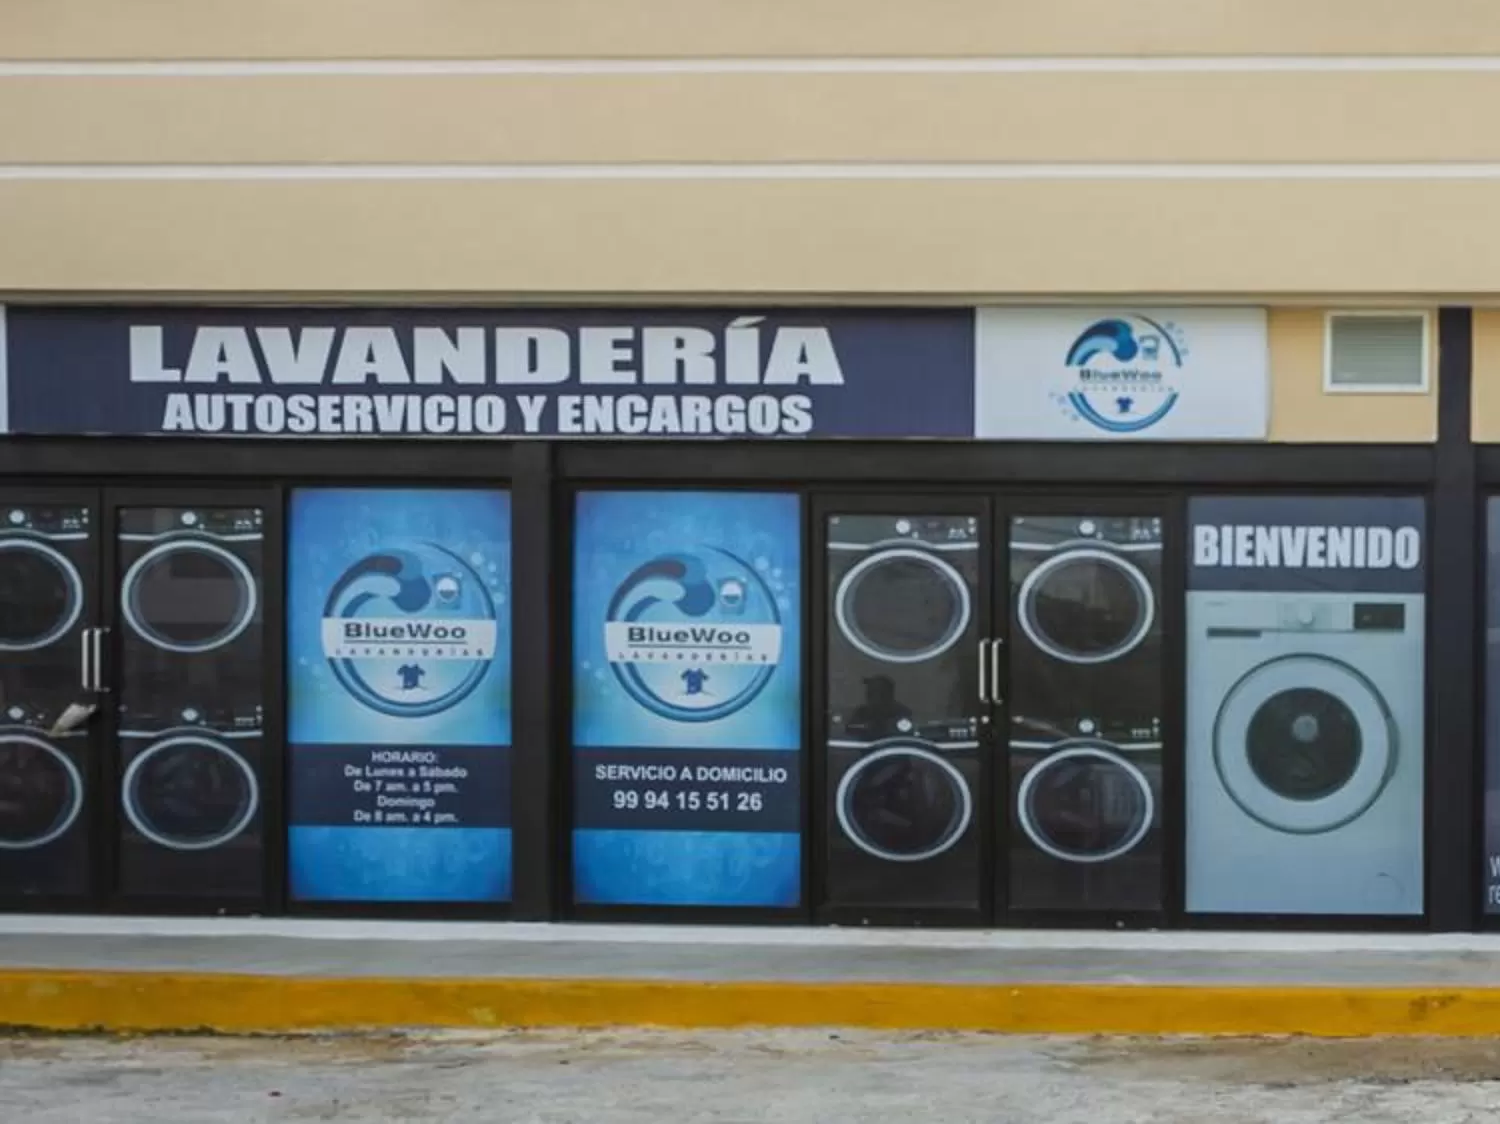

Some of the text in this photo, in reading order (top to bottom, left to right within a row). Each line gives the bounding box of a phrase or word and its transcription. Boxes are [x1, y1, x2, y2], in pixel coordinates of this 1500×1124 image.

[129, 316, 844, 386] LAVANDERÍA
[163, 394, 813, 434] AUTOSERVICIO Y ENCARGOS
[1193, 524, 1421, 570] BIENVENIDO
[343, 622, 467, 639] BlueWoo
[627, 626, 751, 644] BlueWoo
[344, 764, 362, 777] De
[365, 765, 405, 777] Lunes
[408, 768, 416, 777] a
[595, 765, 787, 783] SERVICIO A DOMICILIO
[353, 780, 372, 792] De
[375, 780, 383, 792] 7
[412, 783, 420, 792] a
[377, 795, 436, 809] Domingo
[613, 790, 763, 811] 99 94 15 51 26
[353, 810, 372, 822] De
[412, 813, 420, 822] a
[423, 810, 431, 822] 4
